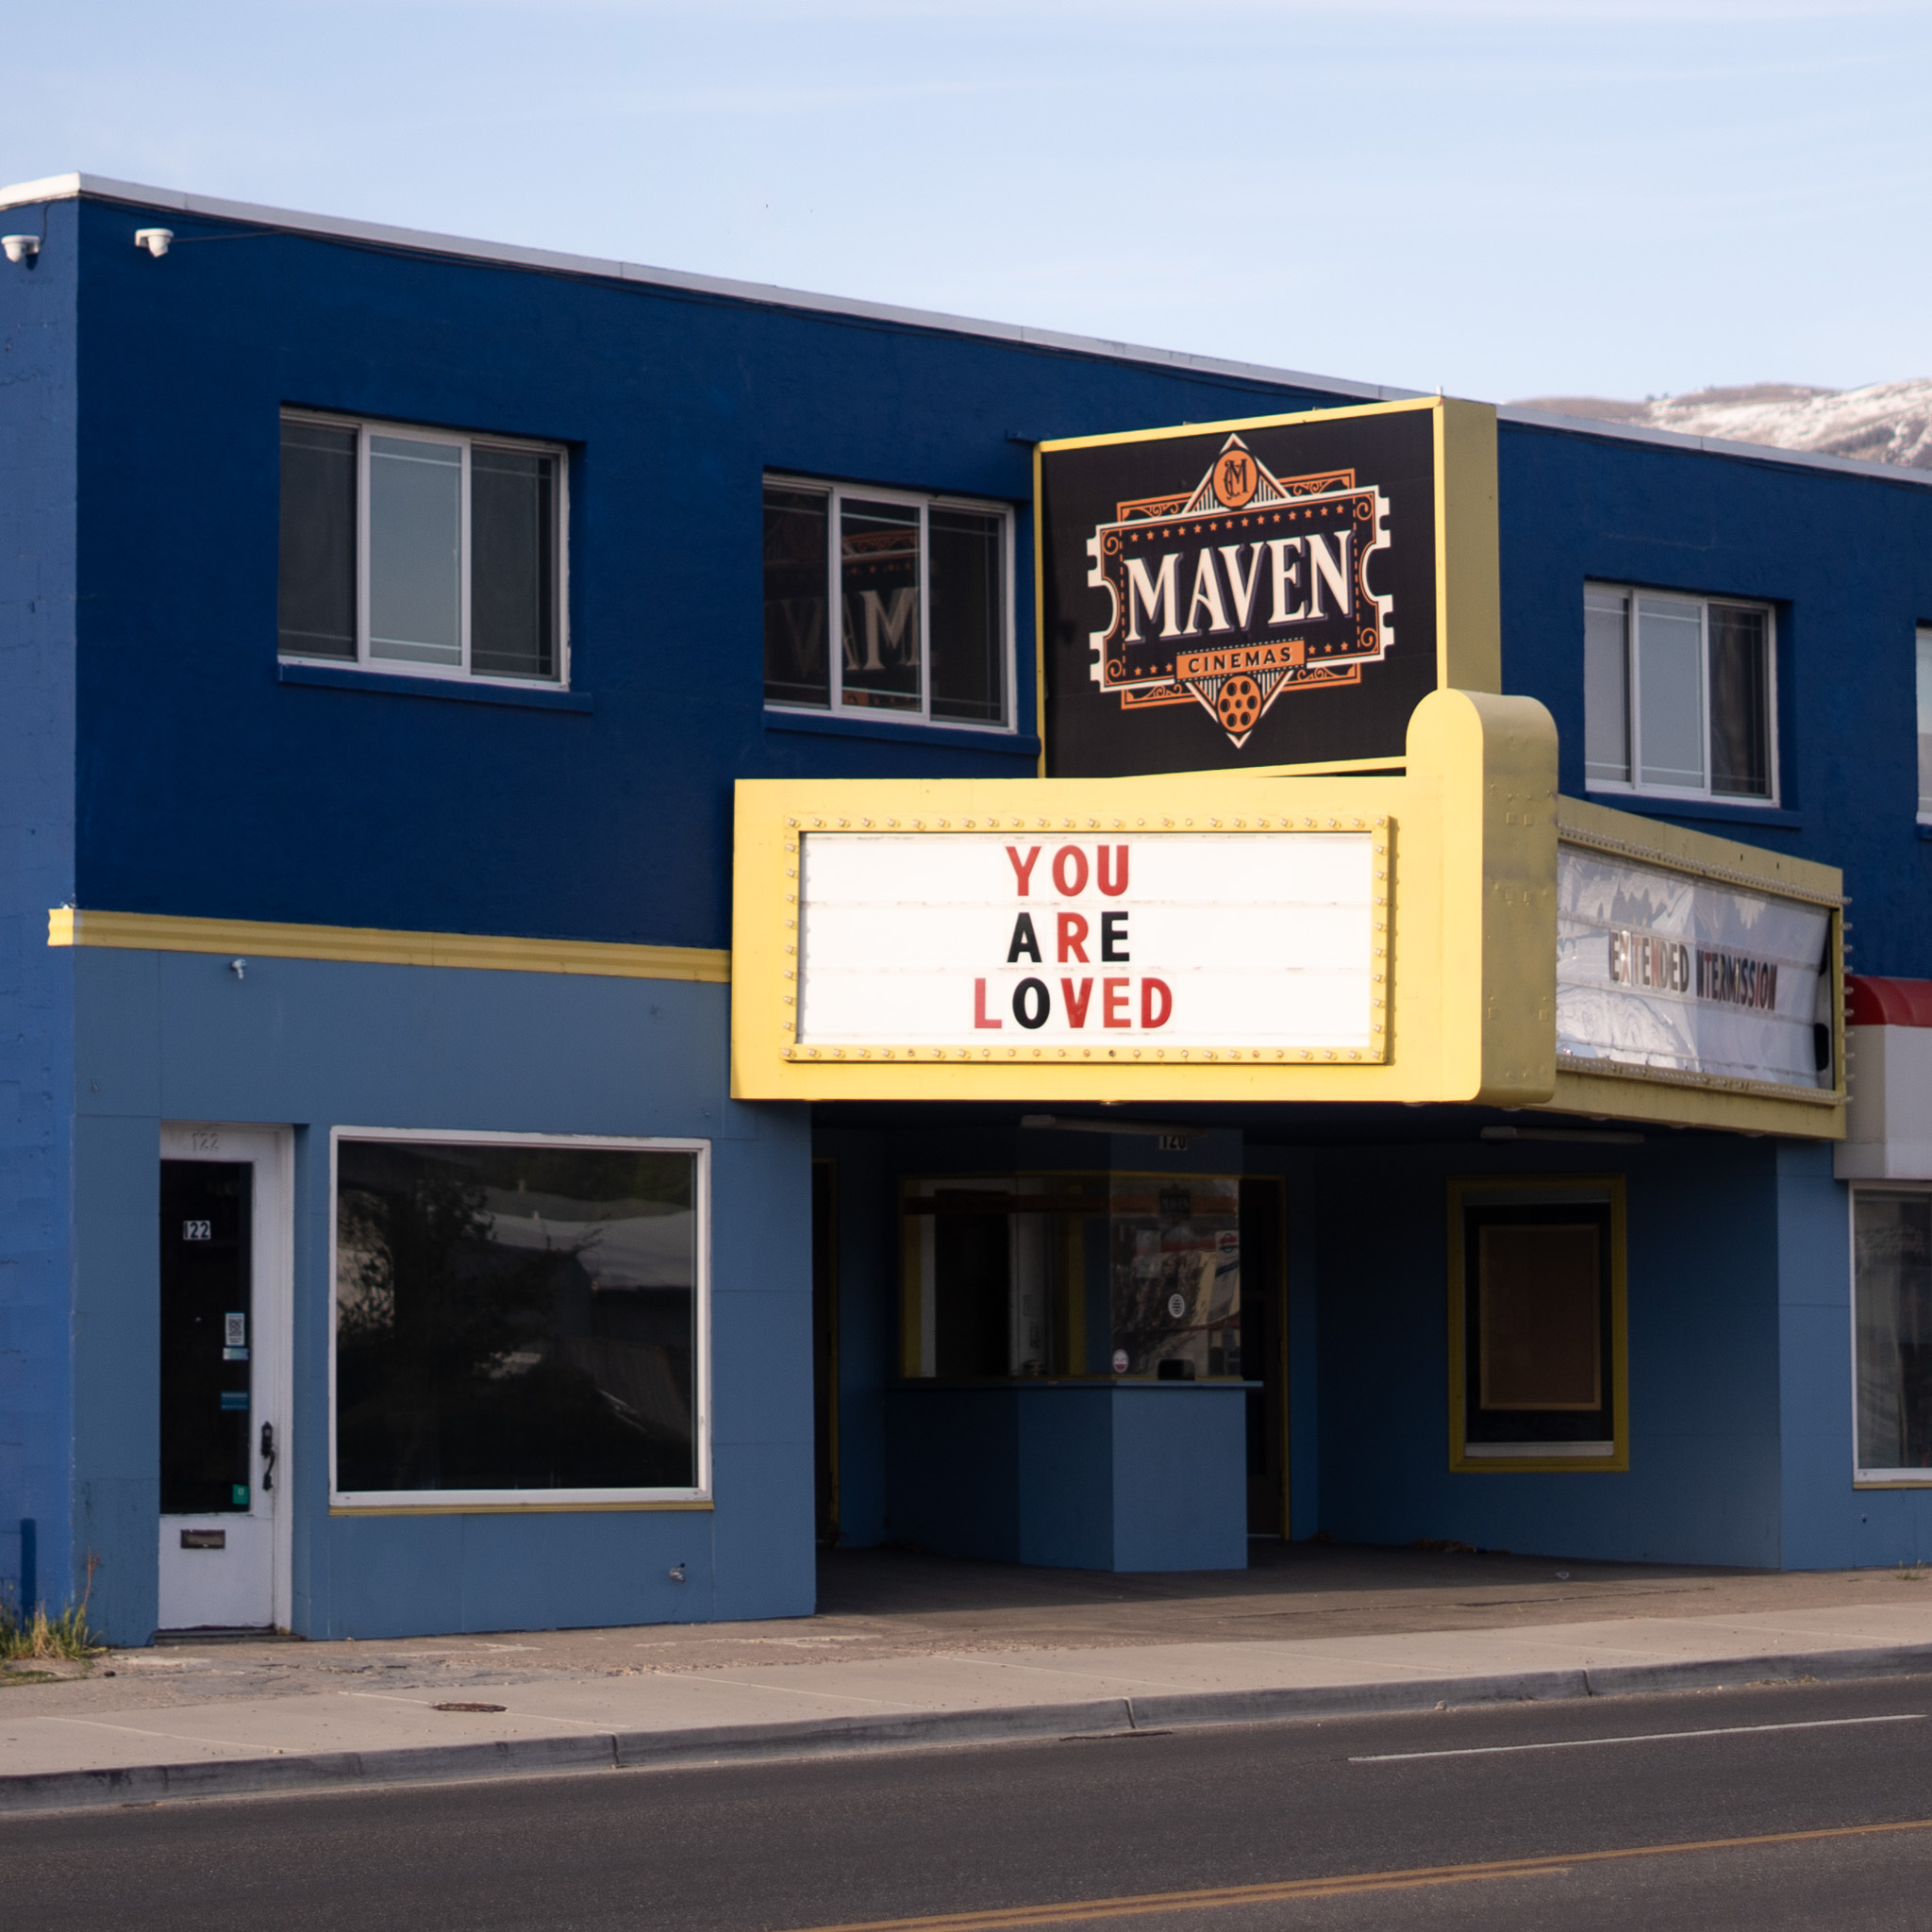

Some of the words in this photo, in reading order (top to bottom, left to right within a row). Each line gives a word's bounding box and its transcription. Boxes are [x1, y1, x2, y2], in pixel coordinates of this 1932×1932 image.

[1124, 529, 1356, 642] MAVEN
[1189, 647, 1292, 674] CINEMAS
[1005, 844, 1130, 897] YOU
[1007, 911, 1131, 963] ARE
[1610, 931, 1690, 992] EXTENDED
[974, 977, 1173, 1029] LOVED
[192, 1133, 220, 1152] 122
[1163, 1135, 1187, 1150] 120
[185, 1222, 209, 1239] 122
